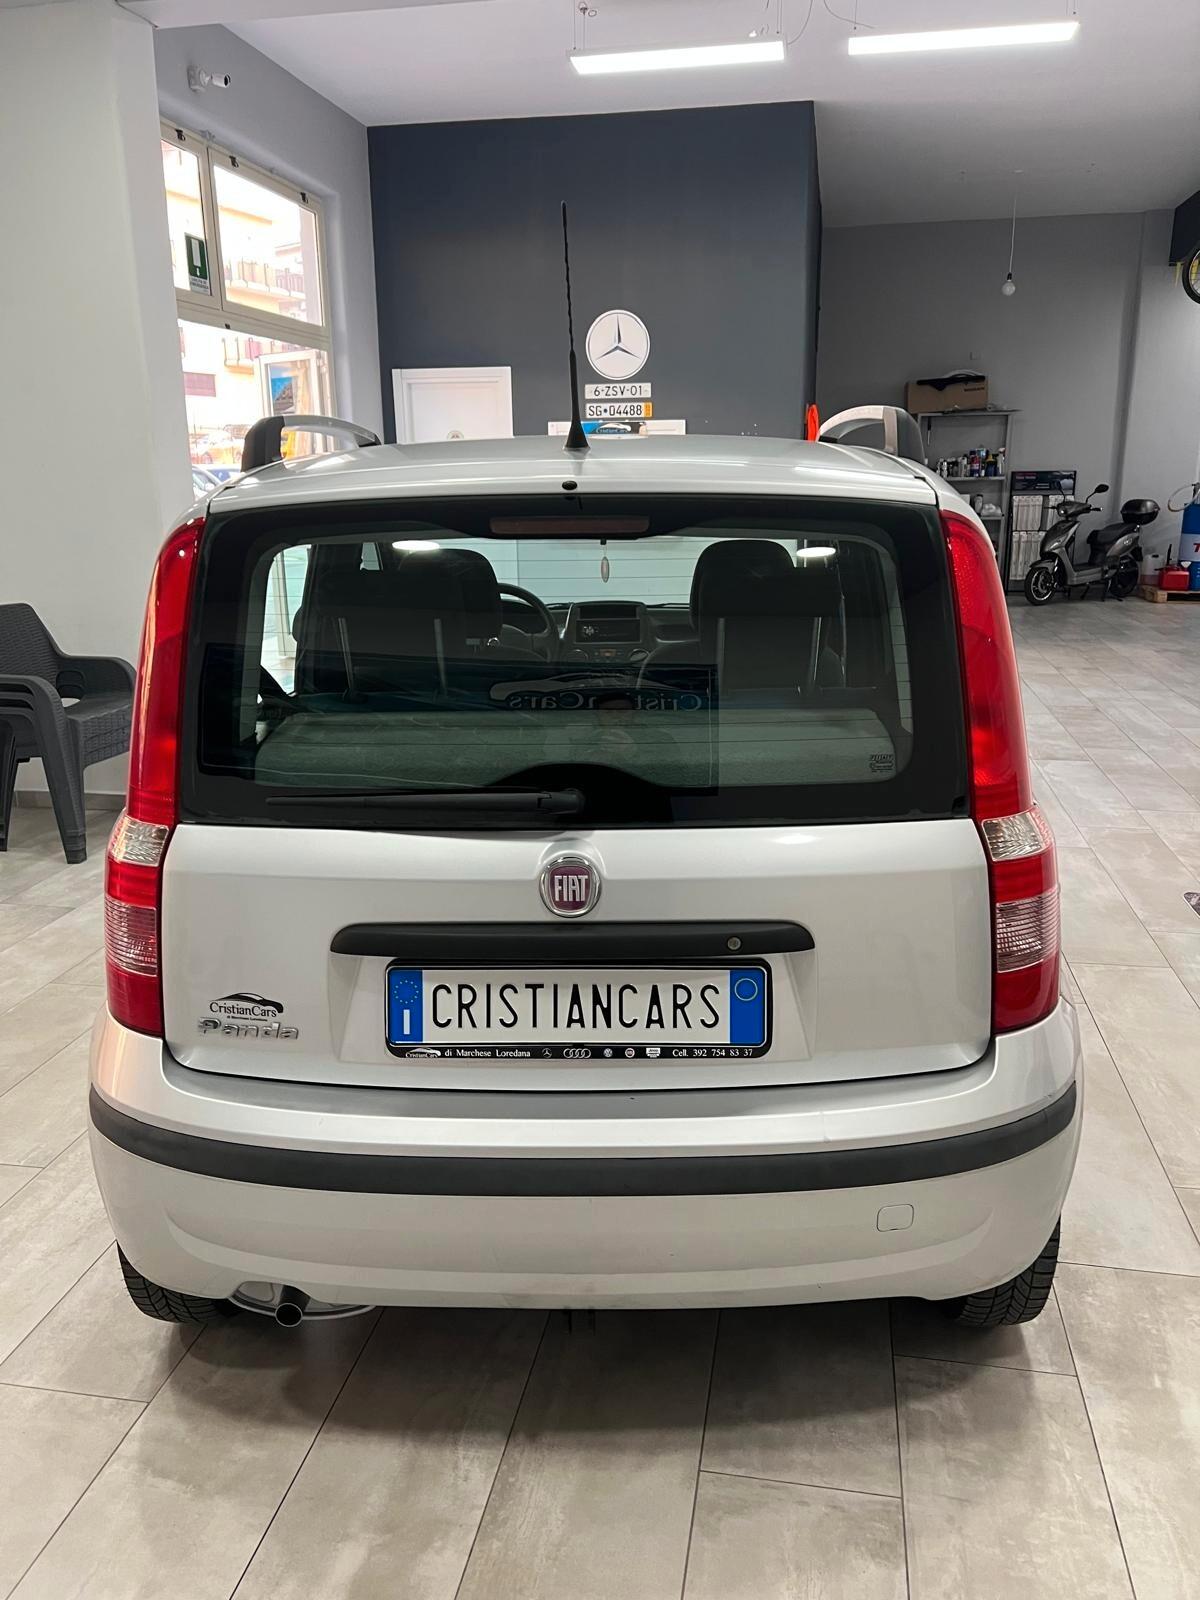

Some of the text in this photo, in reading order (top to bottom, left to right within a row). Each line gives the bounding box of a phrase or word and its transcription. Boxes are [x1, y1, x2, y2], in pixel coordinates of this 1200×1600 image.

[593, 385, 643, 397] 6-ZSV-01
[554, 875, 588, 902] FIAT
[209, 1001, 277, 1017] CristianCars
[432, 983, 720, 1029] CRISTIANCARS
[198, 1017, 299, 1040] Panda
[403, 1009, 411, 1035] I
[444, 1048, 452, 1057] di
[456, 1048, 492, 1057] Marchese
[496, 1048, 531, 1057] Loredana
[672, 1049, 689, 1057] Cell.
[692, 1049, 707, 1057] 392
[712, 1049, 726, 1057] 754
[730, 1049, 740, 1057] 83
[743, 1049, 753, 1057] 37
